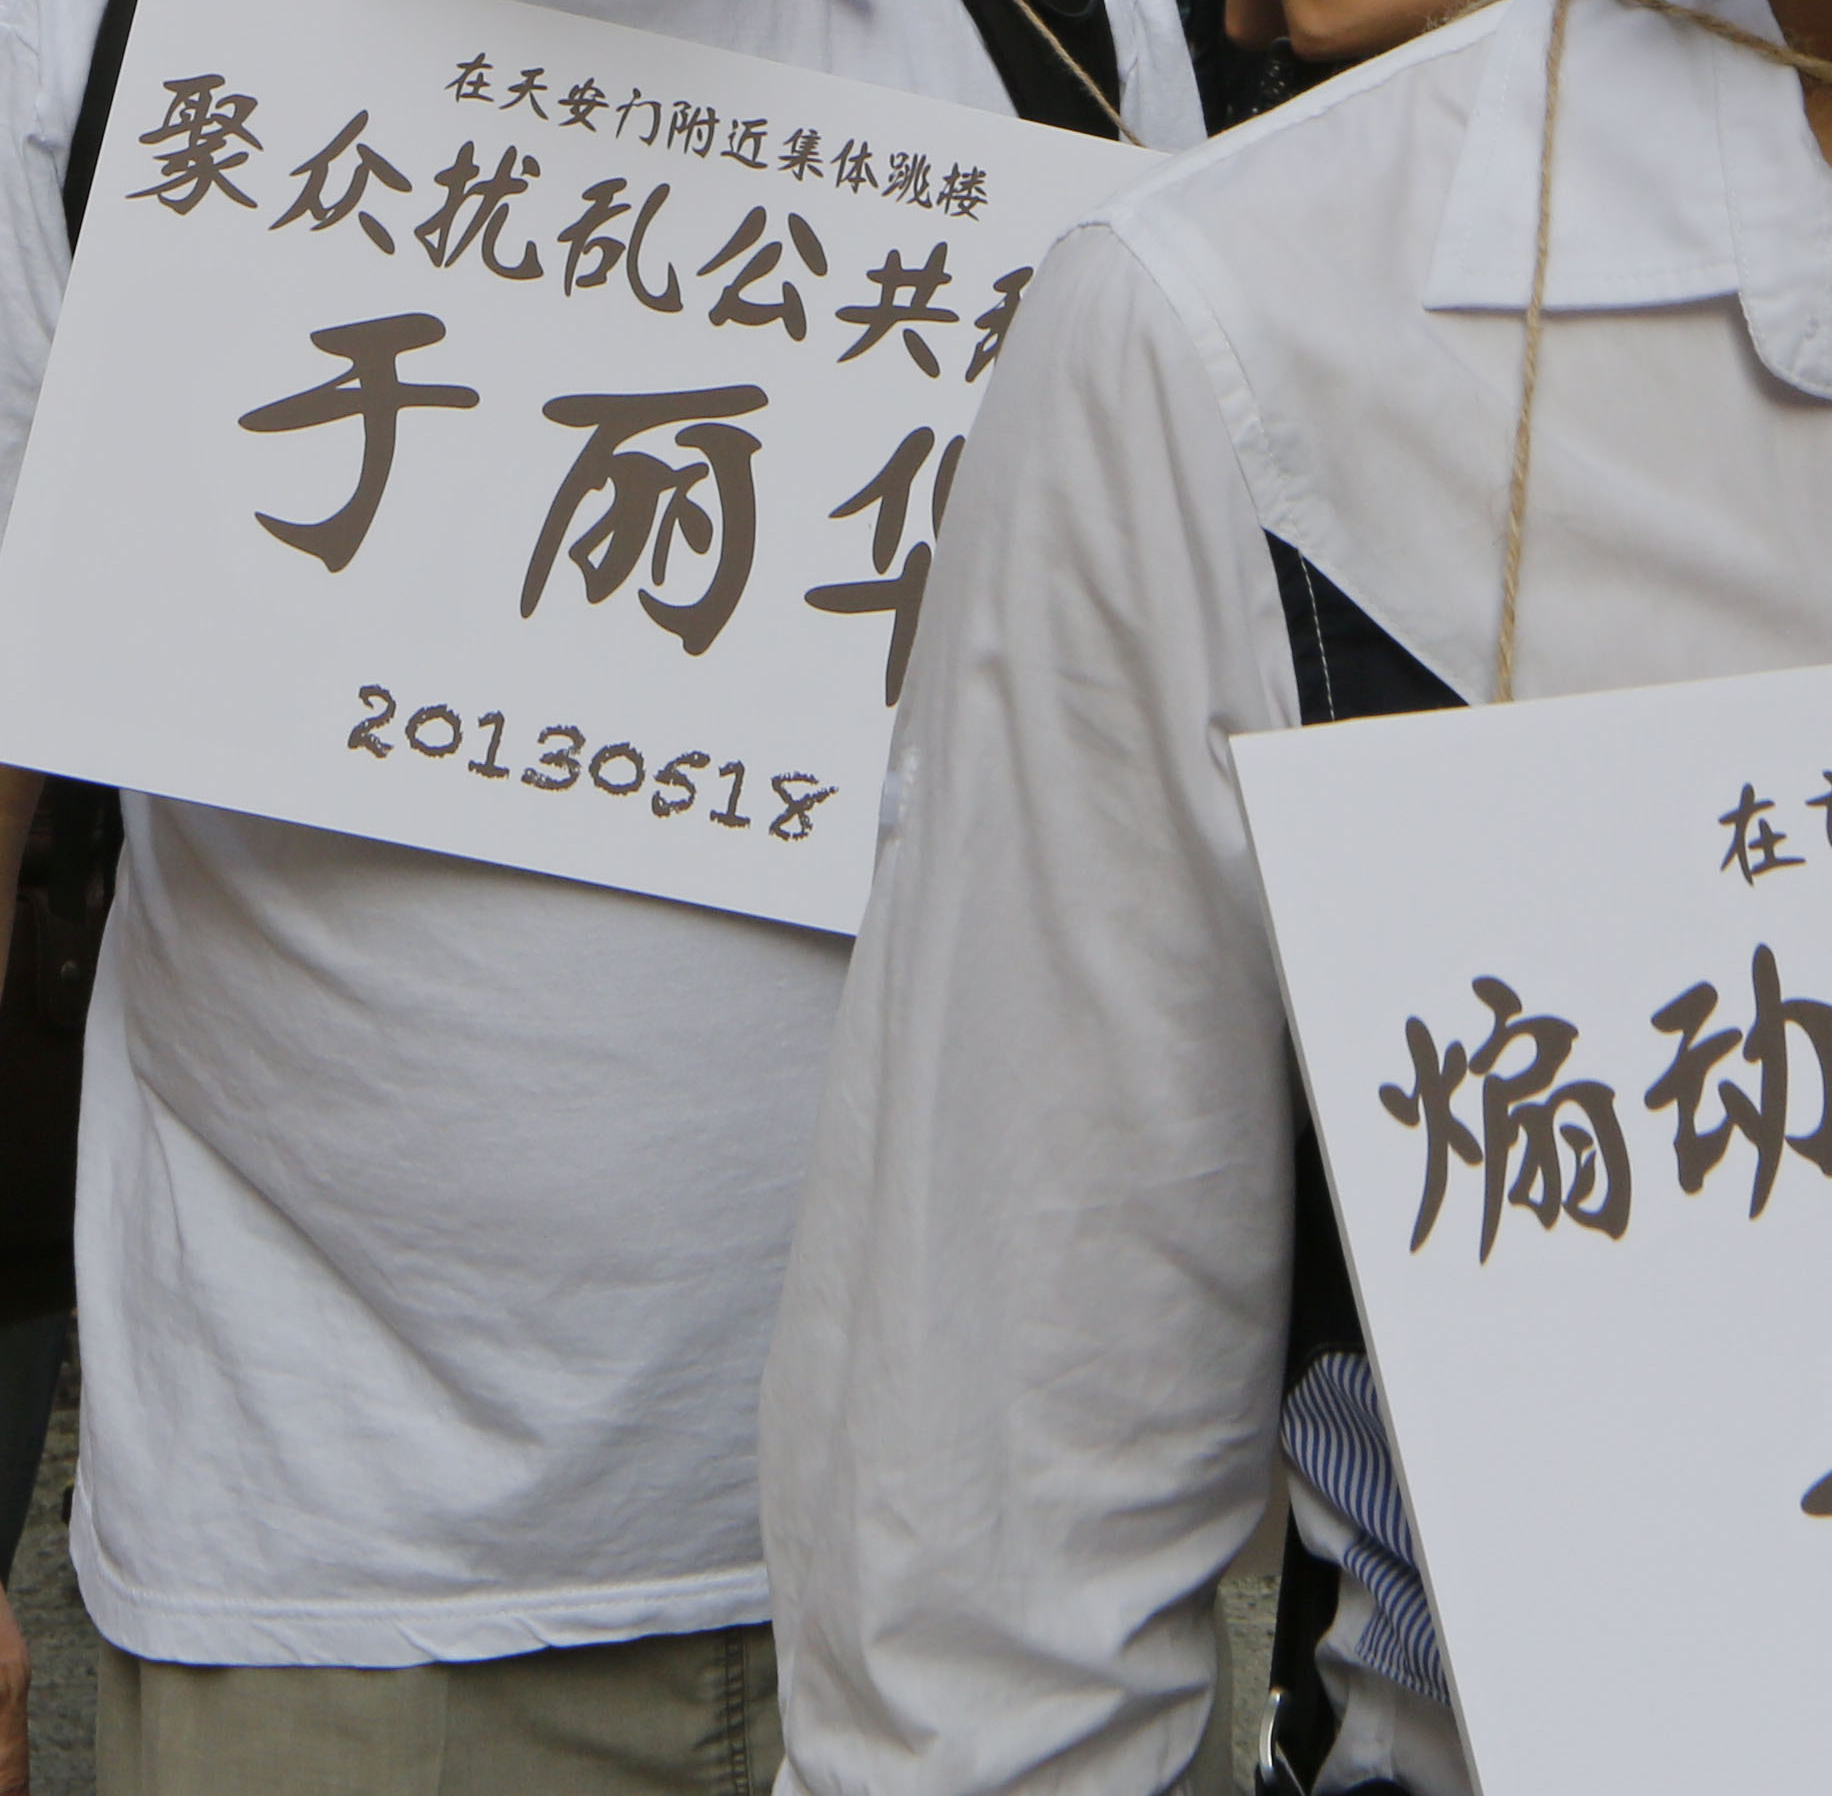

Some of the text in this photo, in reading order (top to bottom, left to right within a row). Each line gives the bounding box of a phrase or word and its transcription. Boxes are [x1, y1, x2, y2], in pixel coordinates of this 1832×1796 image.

[444, 52, 989, 222] 在天安门附近集体跳楼
[237, 312, 965, 708] 于丽华
[347, 683, 839, 842] 20130518
